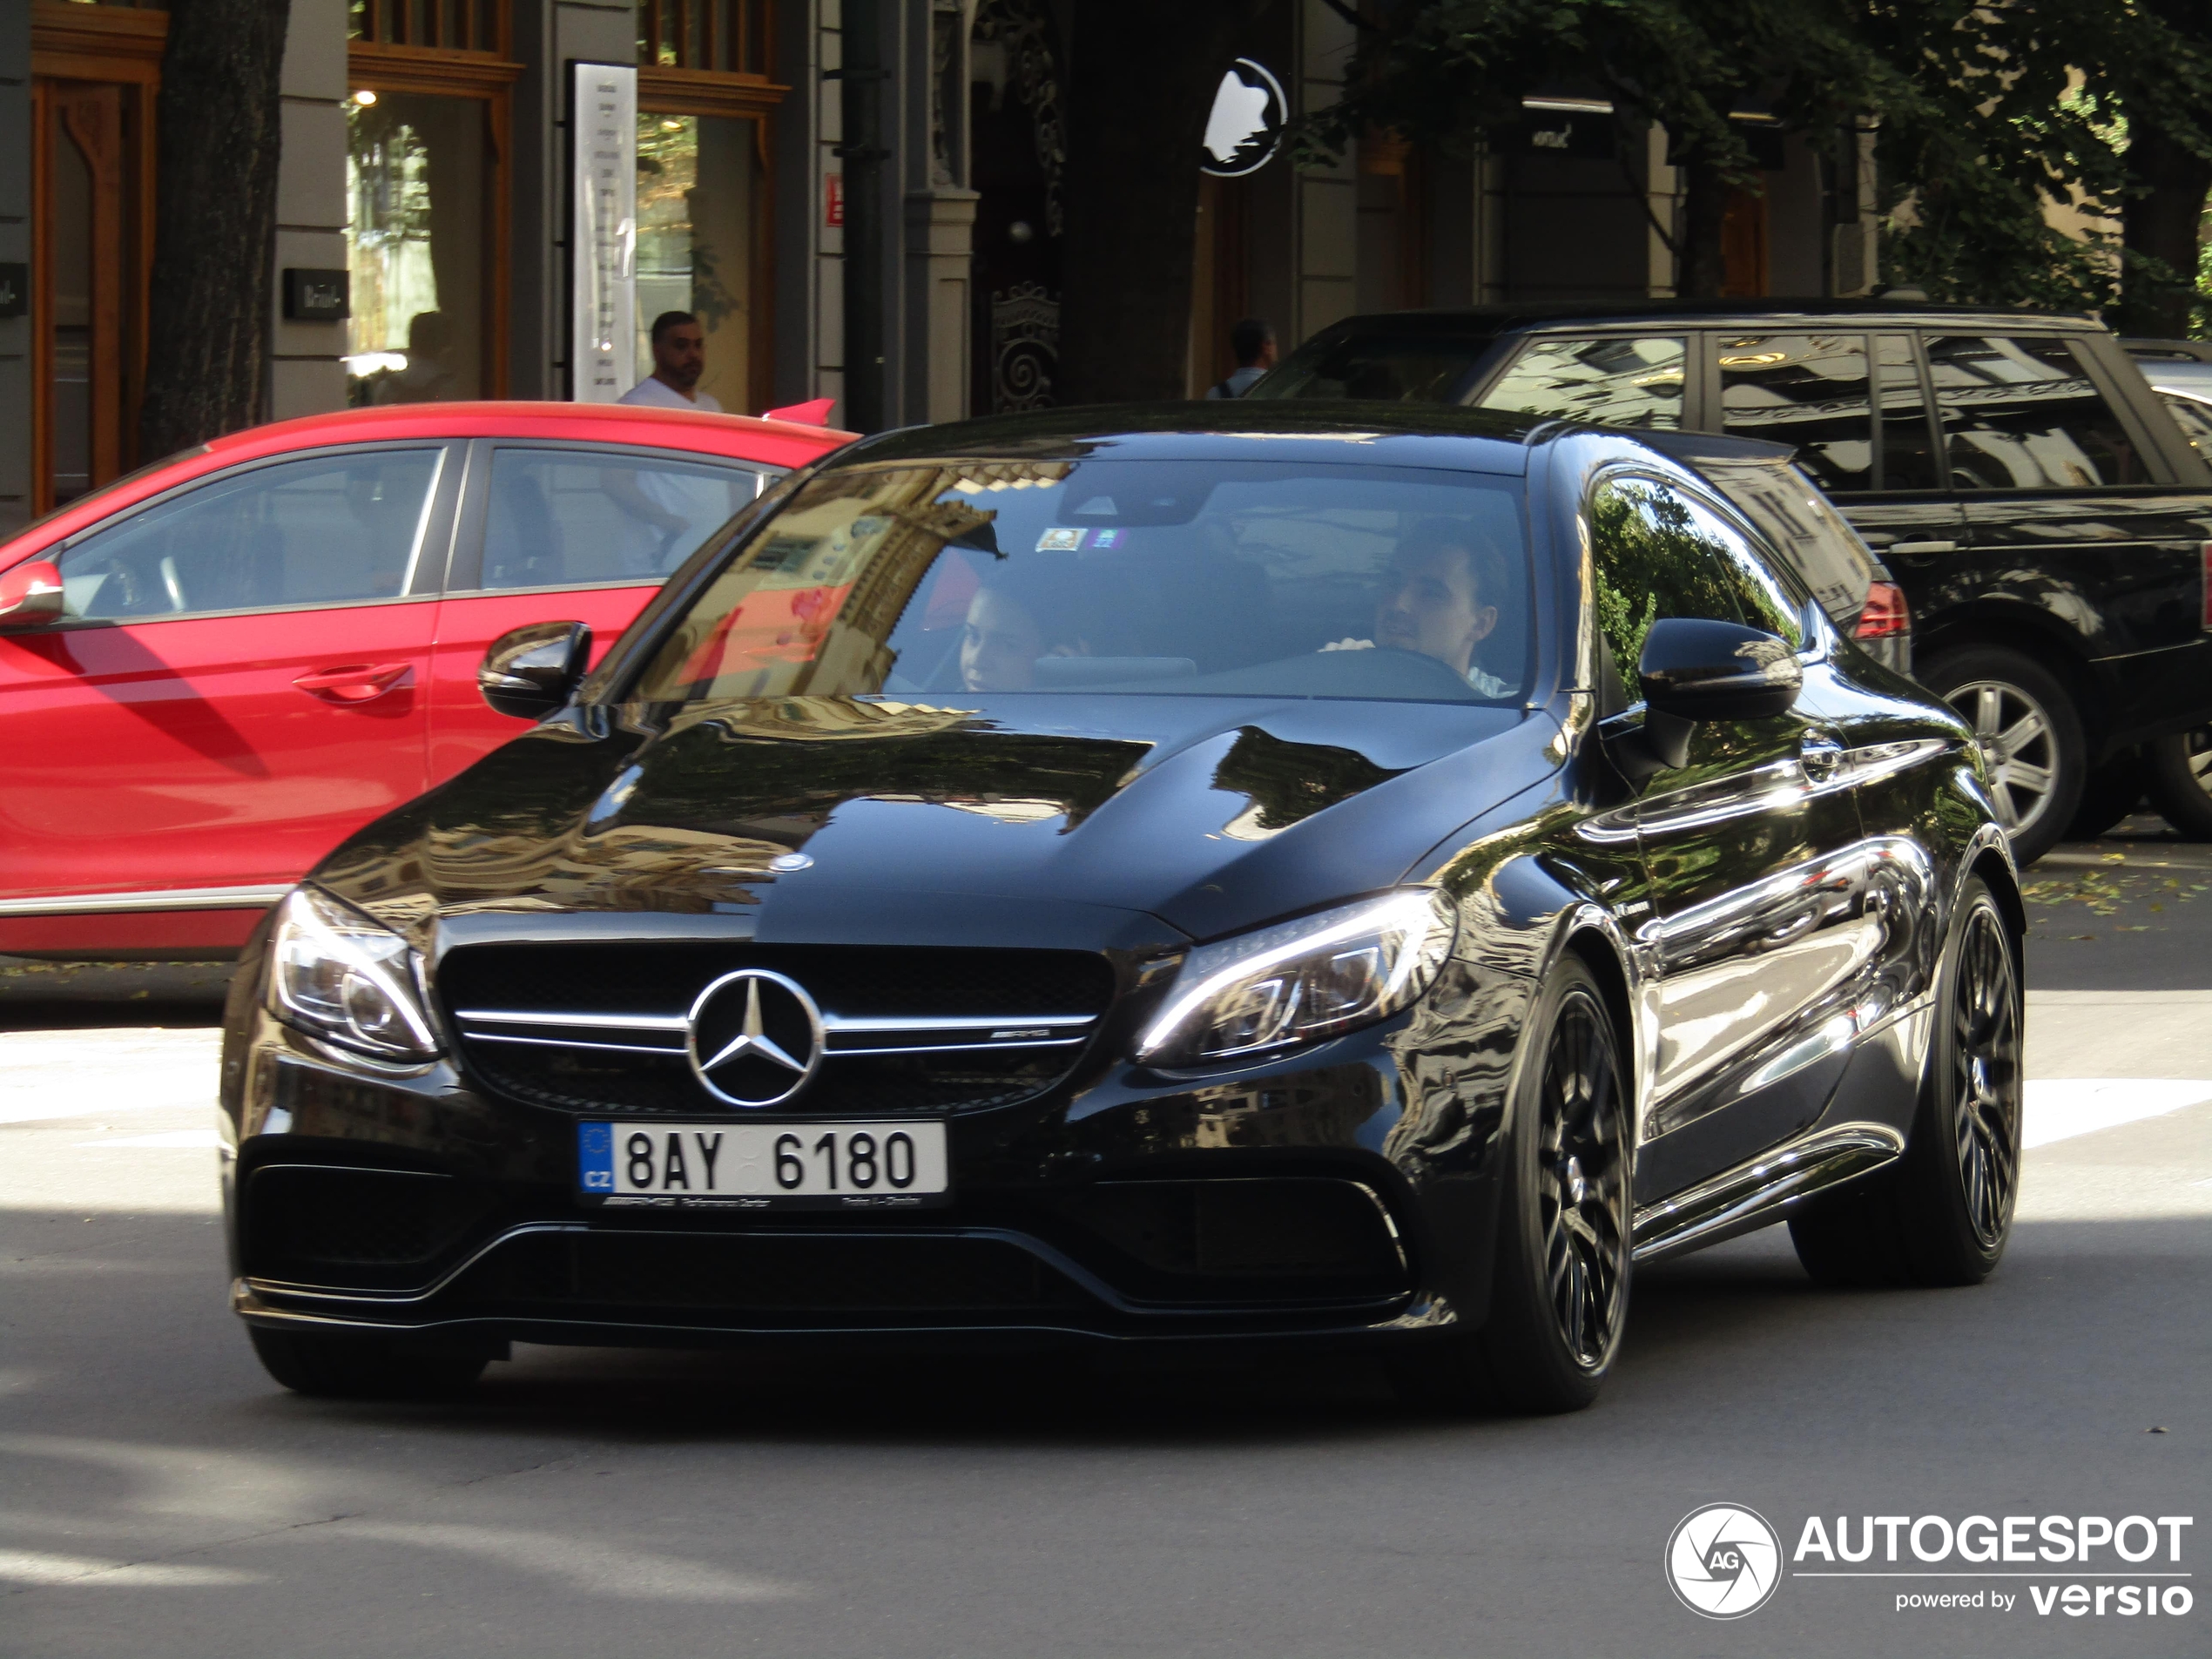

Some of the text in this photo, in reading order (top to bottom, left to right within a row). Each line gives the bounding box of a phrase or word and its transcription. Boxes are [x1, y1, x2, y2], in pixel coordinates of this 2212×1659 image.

[584, 1170, 611, 1188] CZ
[626, 1131, 916, 1190] 8AY 6180
